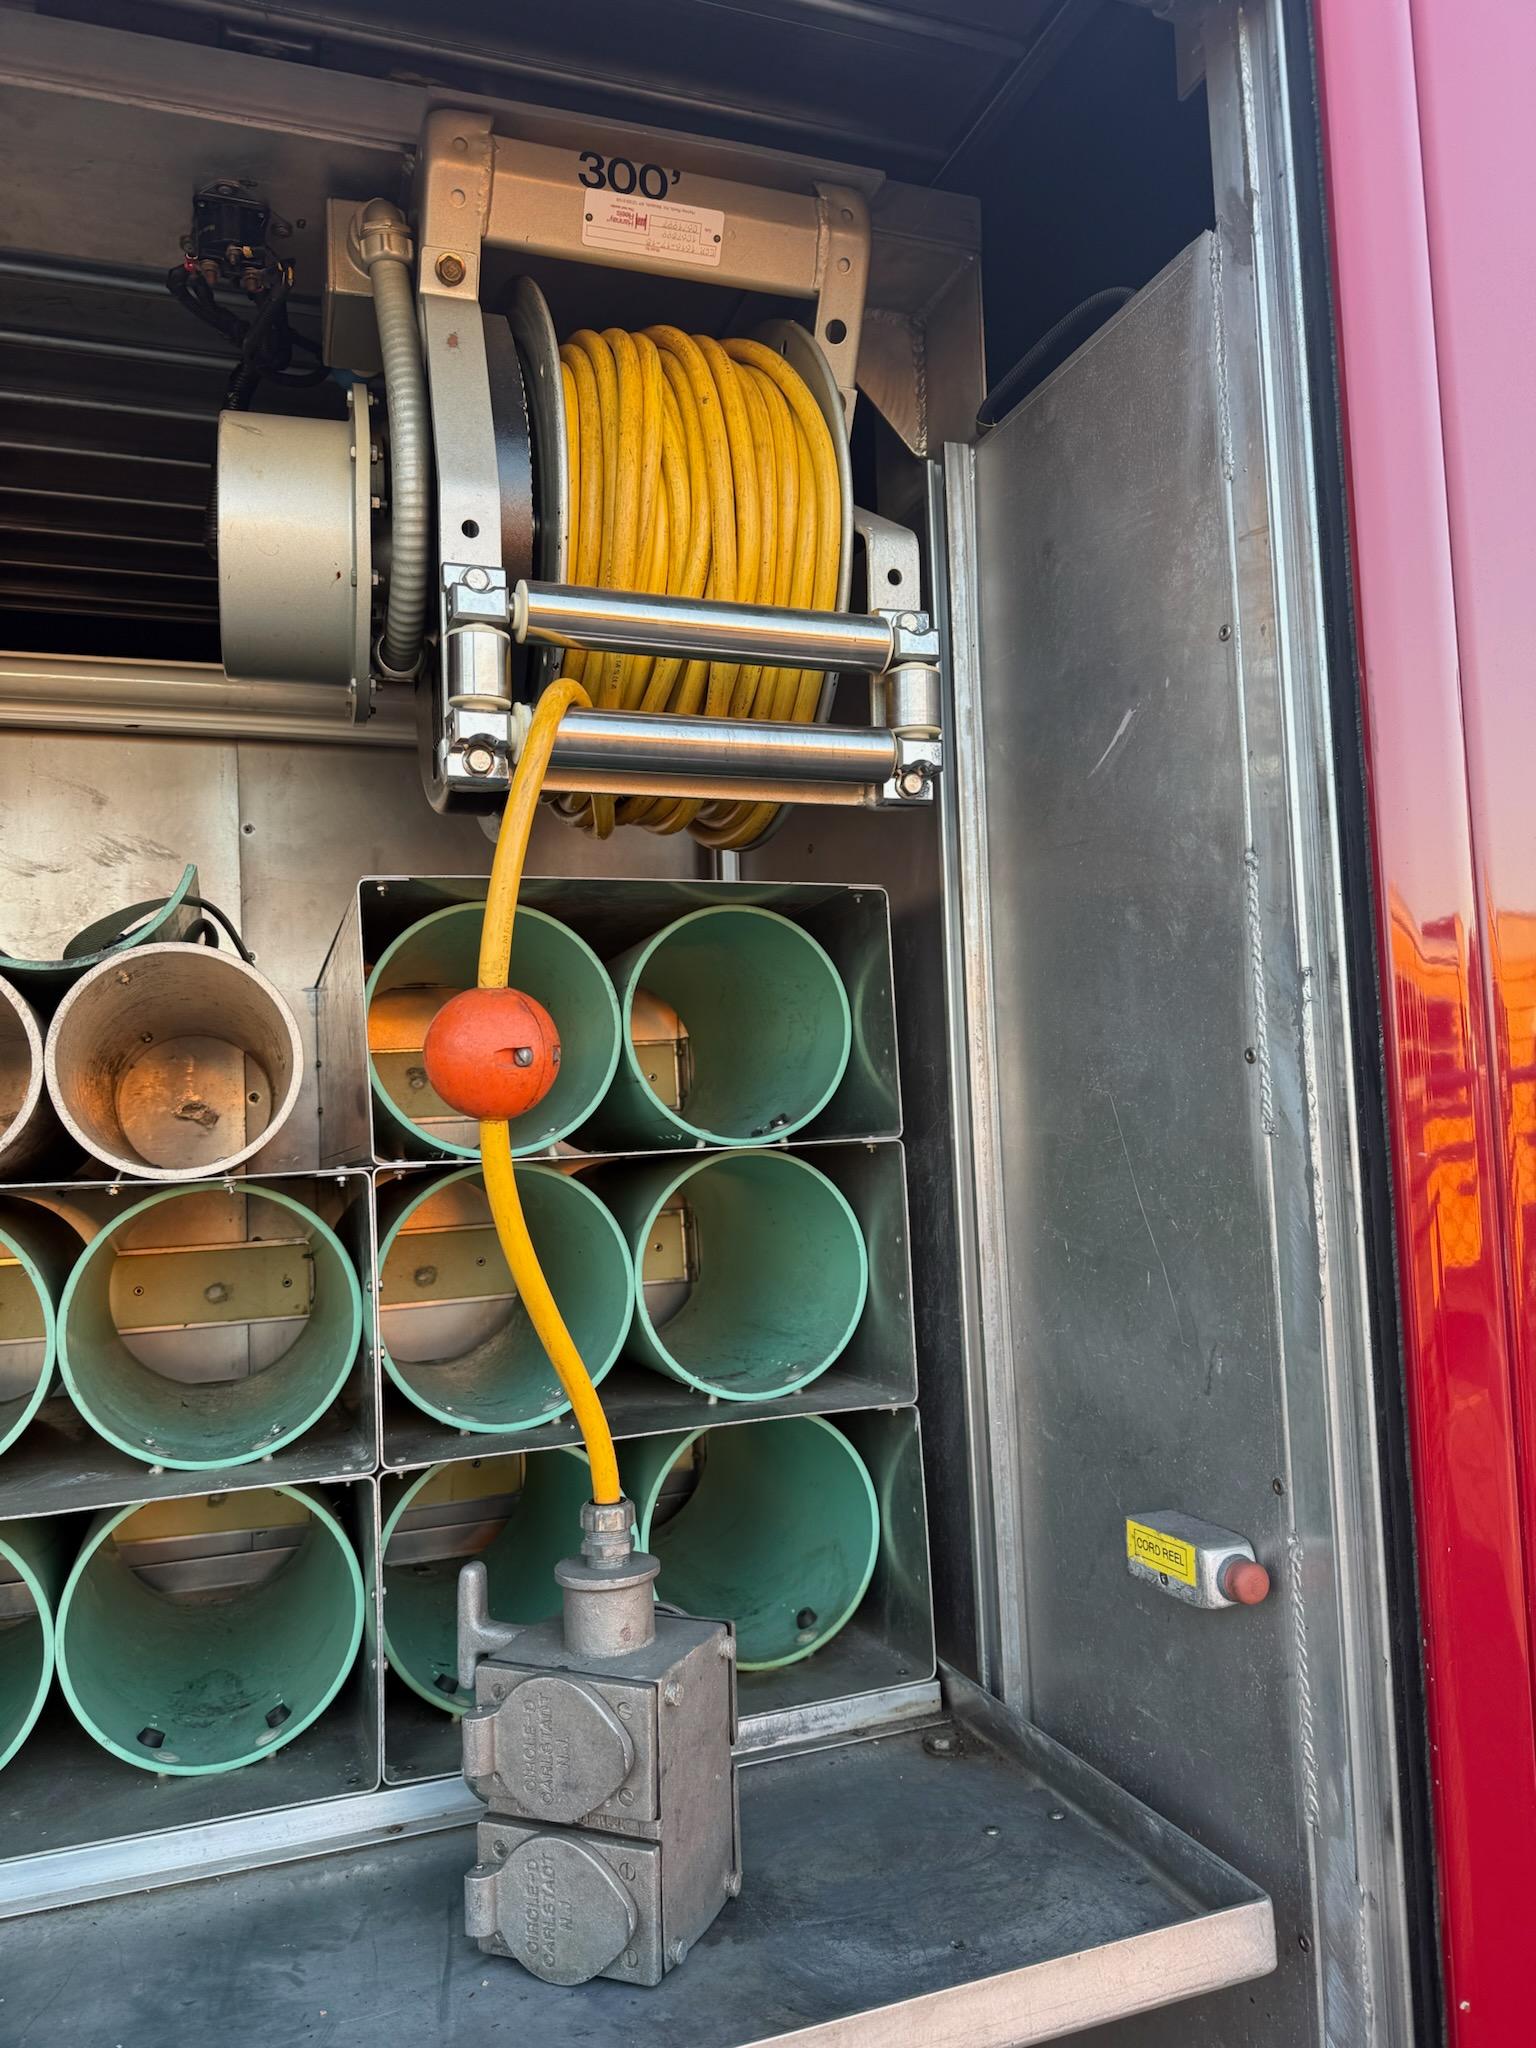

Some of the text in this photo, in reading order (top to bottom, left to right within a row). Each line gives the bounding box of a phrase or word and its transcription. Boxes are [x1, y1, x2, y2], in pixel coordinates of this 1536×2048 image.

[1136, 1537, 1184, 1566] CORD REEL
[540, 1853, 555, 1968] CARLSTADT
